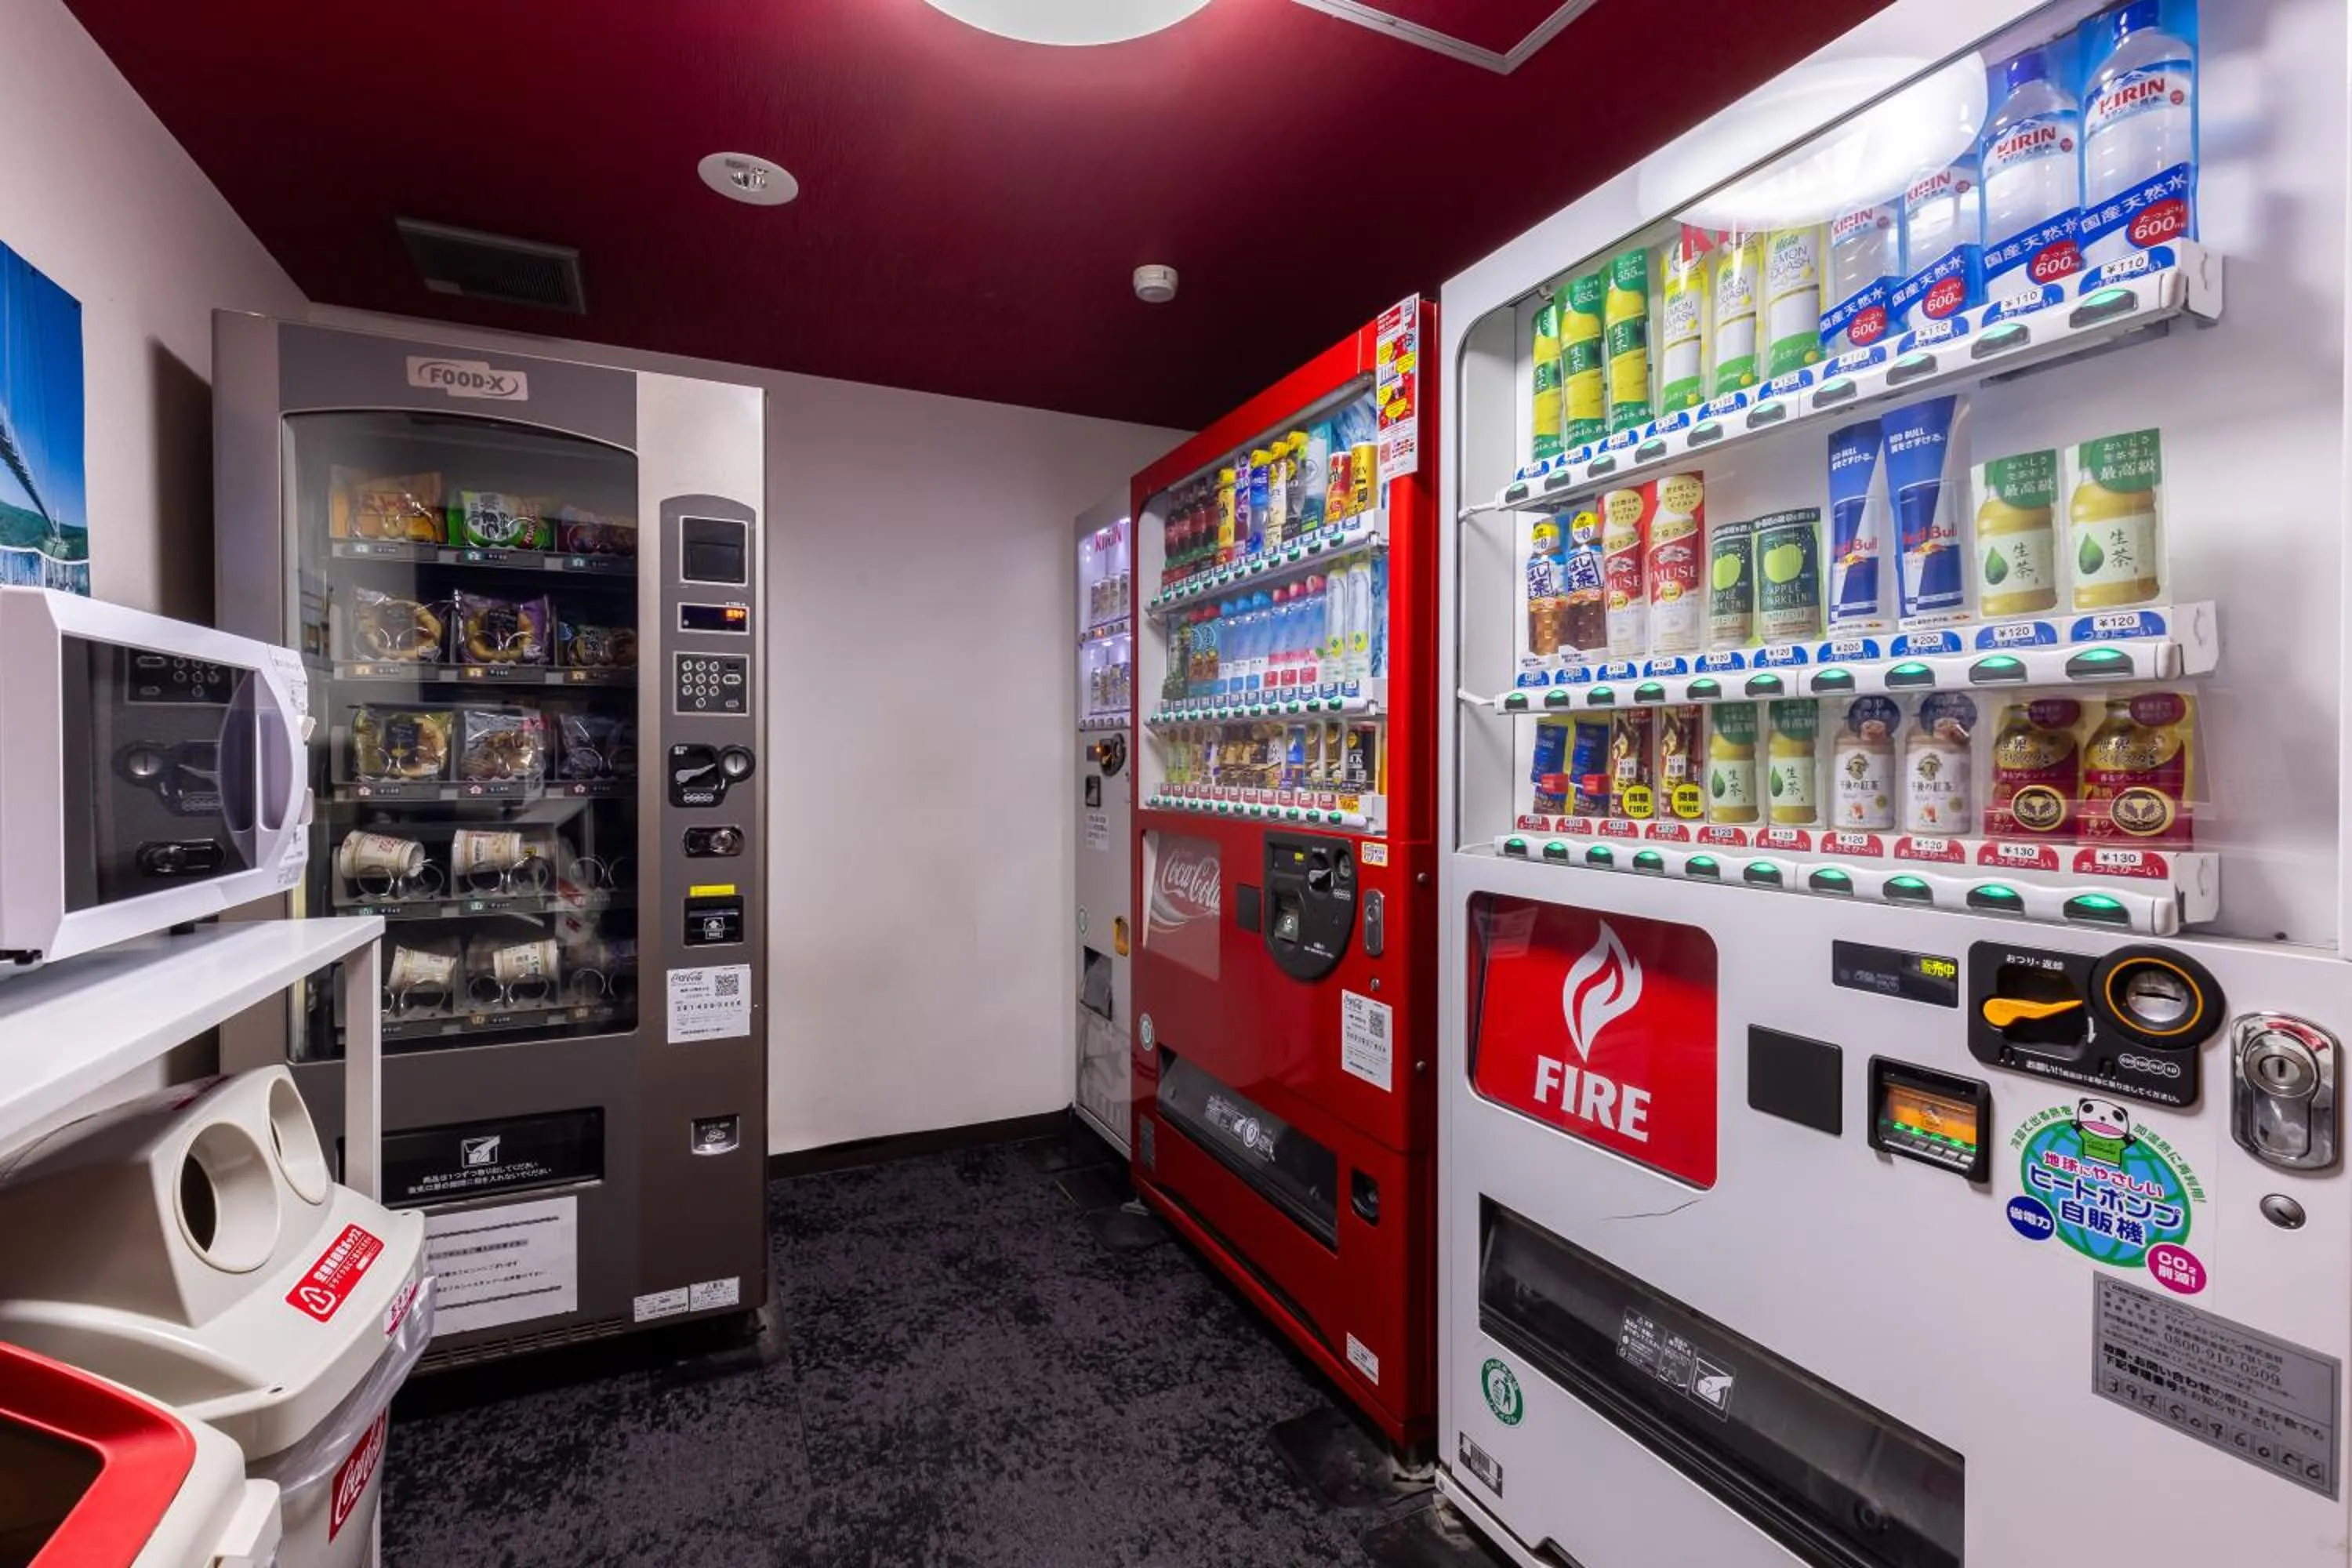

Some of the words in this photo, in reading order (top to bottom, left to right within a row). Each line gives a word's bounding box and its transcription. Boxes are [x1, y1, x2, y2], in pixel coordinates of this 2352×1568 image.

[2100, 78, 2165, 114] KIRIN
[1997, 126, 2056, 154] KIRIN
[1907, 171, 1952, 200] KIRIN
[2081, 173, 2188, 233] 国産天然水
[1984, 216, 2078, 270] 国産天然水
[2107, 256, 2144, 274] ¥110
[1893, 256, 1965, 307] 国産天然水
[1904, 428, 1925, 441] BULL
[2100, 461, 2156, 481] 最高級
[1931, 524, 1958, 539] Bull
[1853, 536, 1878, 550] Bull
[2111, 528, 2133, 568] 生茶
[2013, 542, 2034, 578] 生茶
[2099, 615, 2135, 627] ¥120
[1911, 636, 1938, 646] ¥200
[1999, 627, 2030, 638] ¥120
[1835, 642, 1860, 652] ¥200
[1628, 803, 1649, 813] FIRE
[1678, 803, 1699, 813] FIRE
[1711, 829, 1732, 837] ¥120
[1773, 830, 1793, 840] ¥120
[1841, 835, 1864, 844] ¥120
[1916, 841, 1942, 851] ¥120
[2004, 846, 2034, 856] ¥130
[2102, 853, 2137, 863] ¥130
[1921, 958, 1956, 978] 販売中
[1534, 1054, 1652, 1143] FIRE
[2044, 1152, 2164, 1196] 地球にやさしい
[2031, 1165, 2182, 1227] ヒートポンプ
[2009, 1206, 2052, 1230] 省電力
[2061, 1201, 2143, 1246] 自販機
